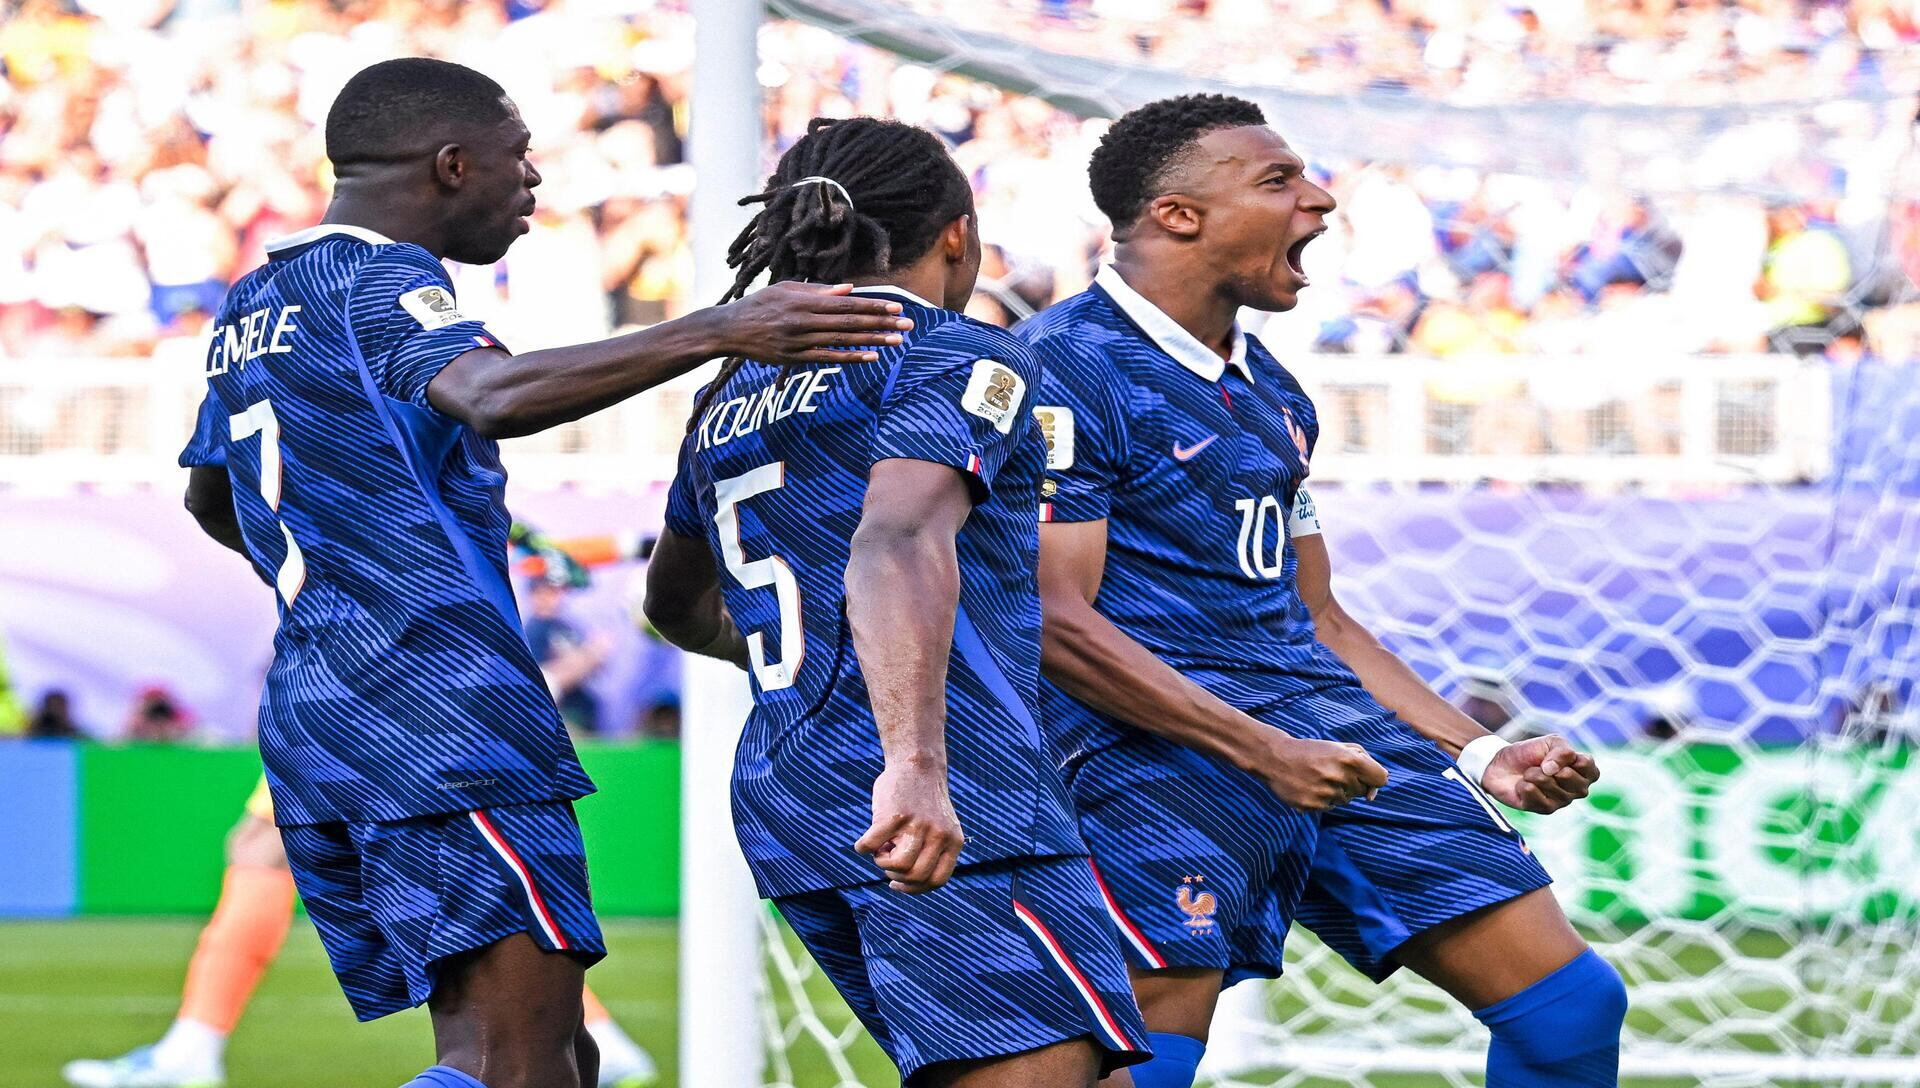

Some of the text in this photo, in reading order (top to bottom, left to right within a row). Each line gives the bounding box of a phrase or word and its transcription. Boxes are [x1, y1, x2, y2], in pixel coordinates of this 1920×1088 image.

[696, 367, 842, 453] KOUNDE
[229, 398, 307, 610] 7
[1235, 495, 1286, 578] 10
[713, 460, 806, 692] 5
[1441, 767, 1512, 833] 1
